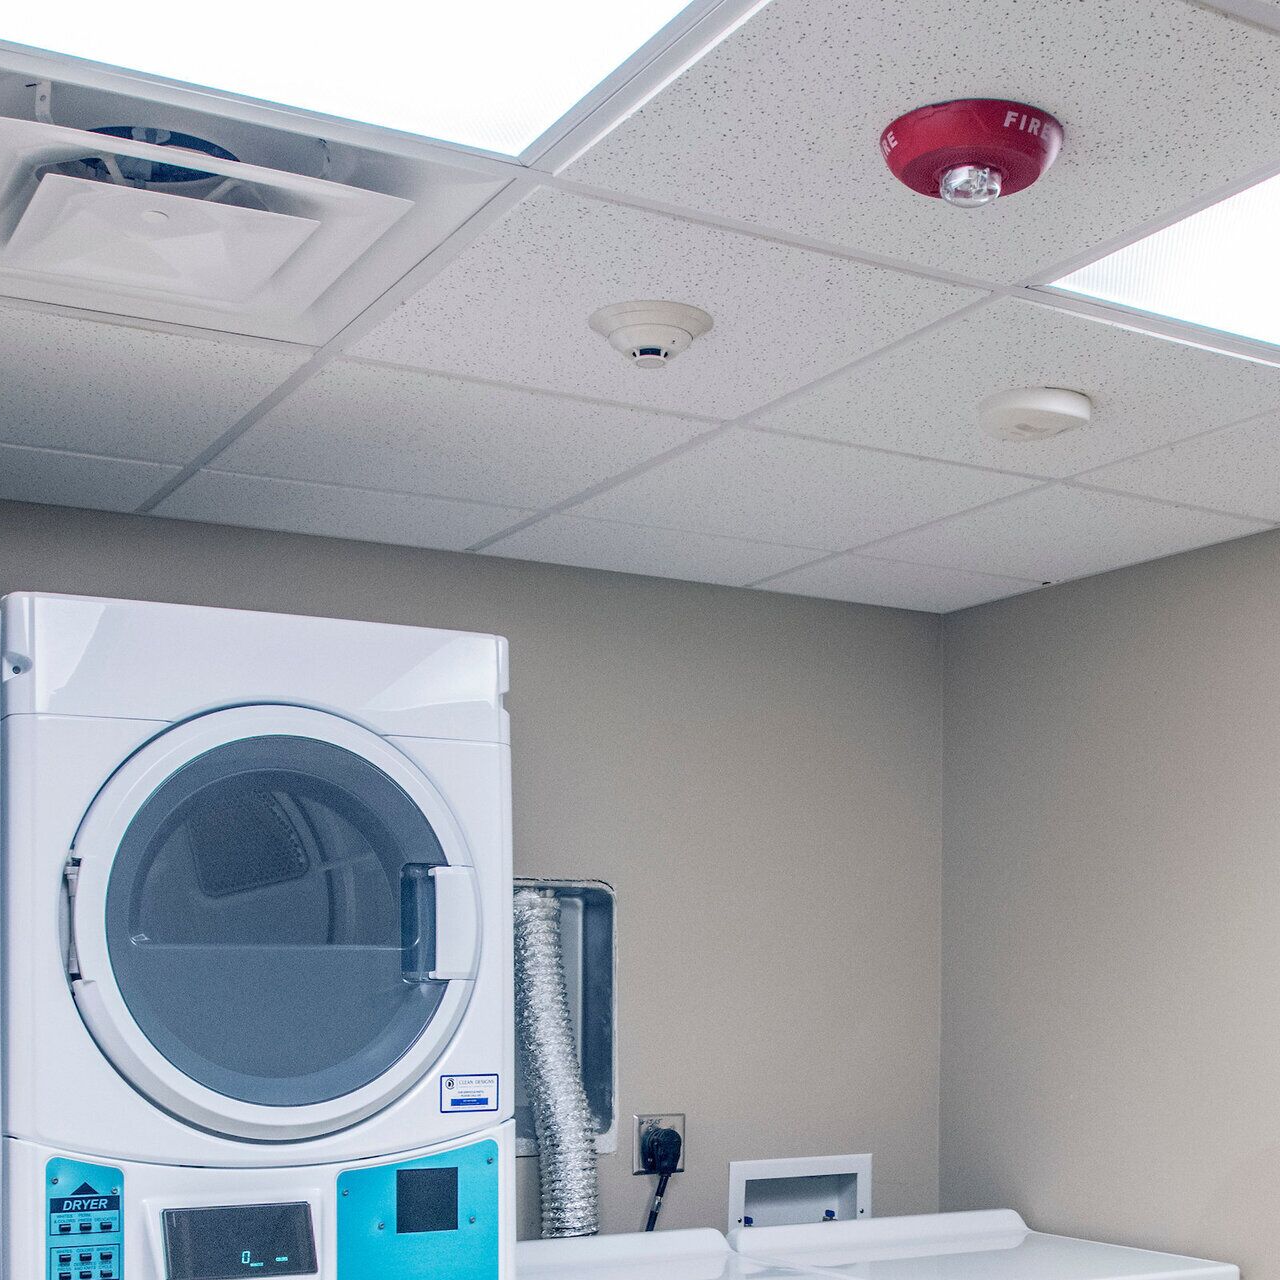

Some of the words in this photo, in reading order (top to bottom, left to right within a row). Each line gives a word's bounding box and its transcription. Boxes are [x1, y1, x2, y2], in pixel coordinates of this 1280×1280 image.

[1003, 111, 1051, 140] FIRE
[63, 1198, 108, 1211] DRYER
[241, 1250, 251, 1264] 0
